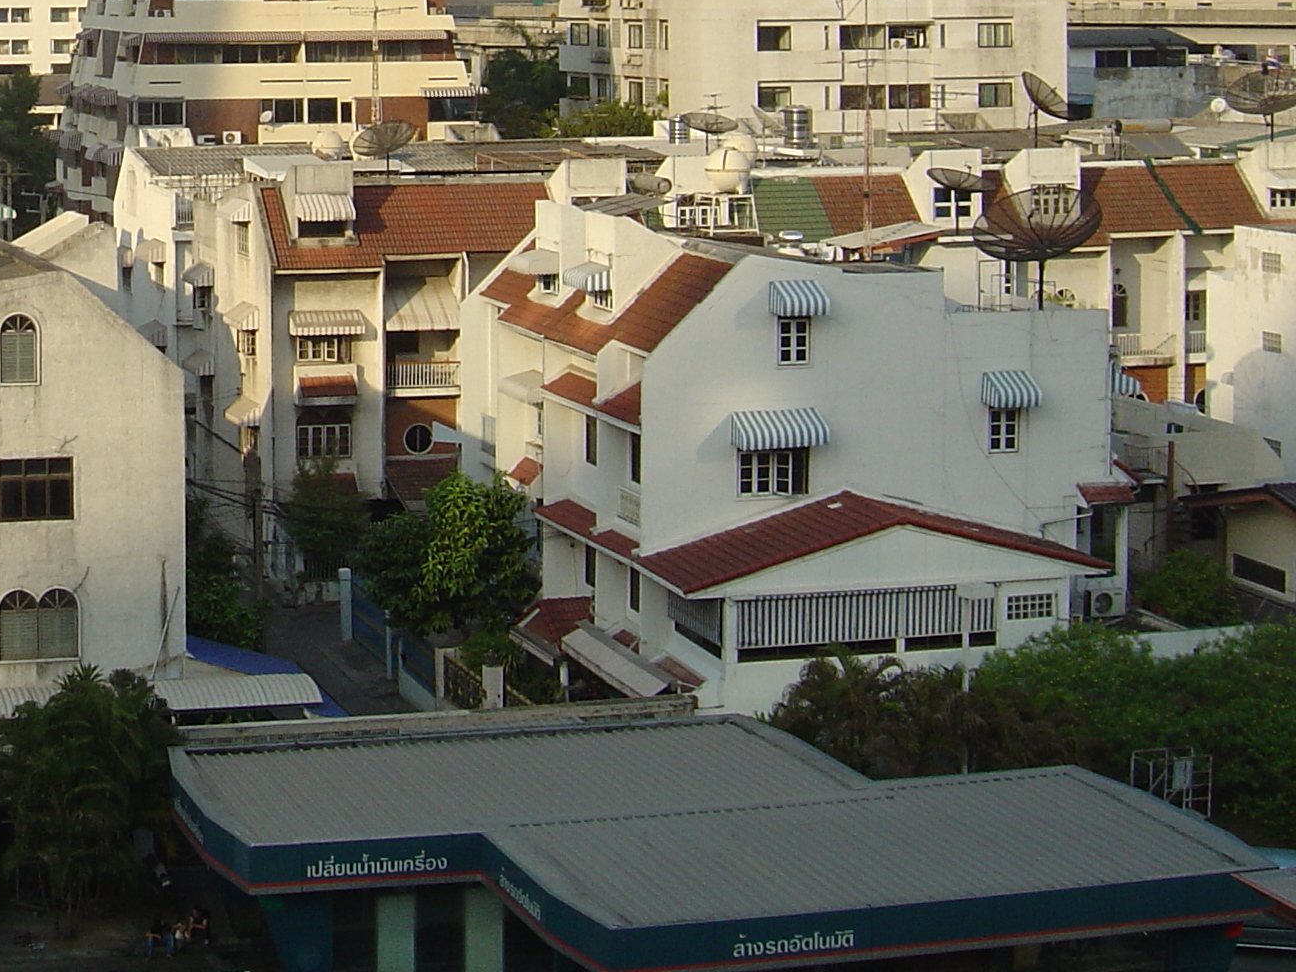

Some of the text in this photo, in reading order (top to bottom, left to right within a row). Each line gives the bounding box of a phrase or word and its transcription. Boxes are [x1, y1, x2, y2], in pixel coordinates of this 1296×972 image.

[307, 850, 448, 878] เปลี่ยนน้ำมันเครื่อง
[733, 930, 854, 958] ล้างรถอัตโนมัติ
